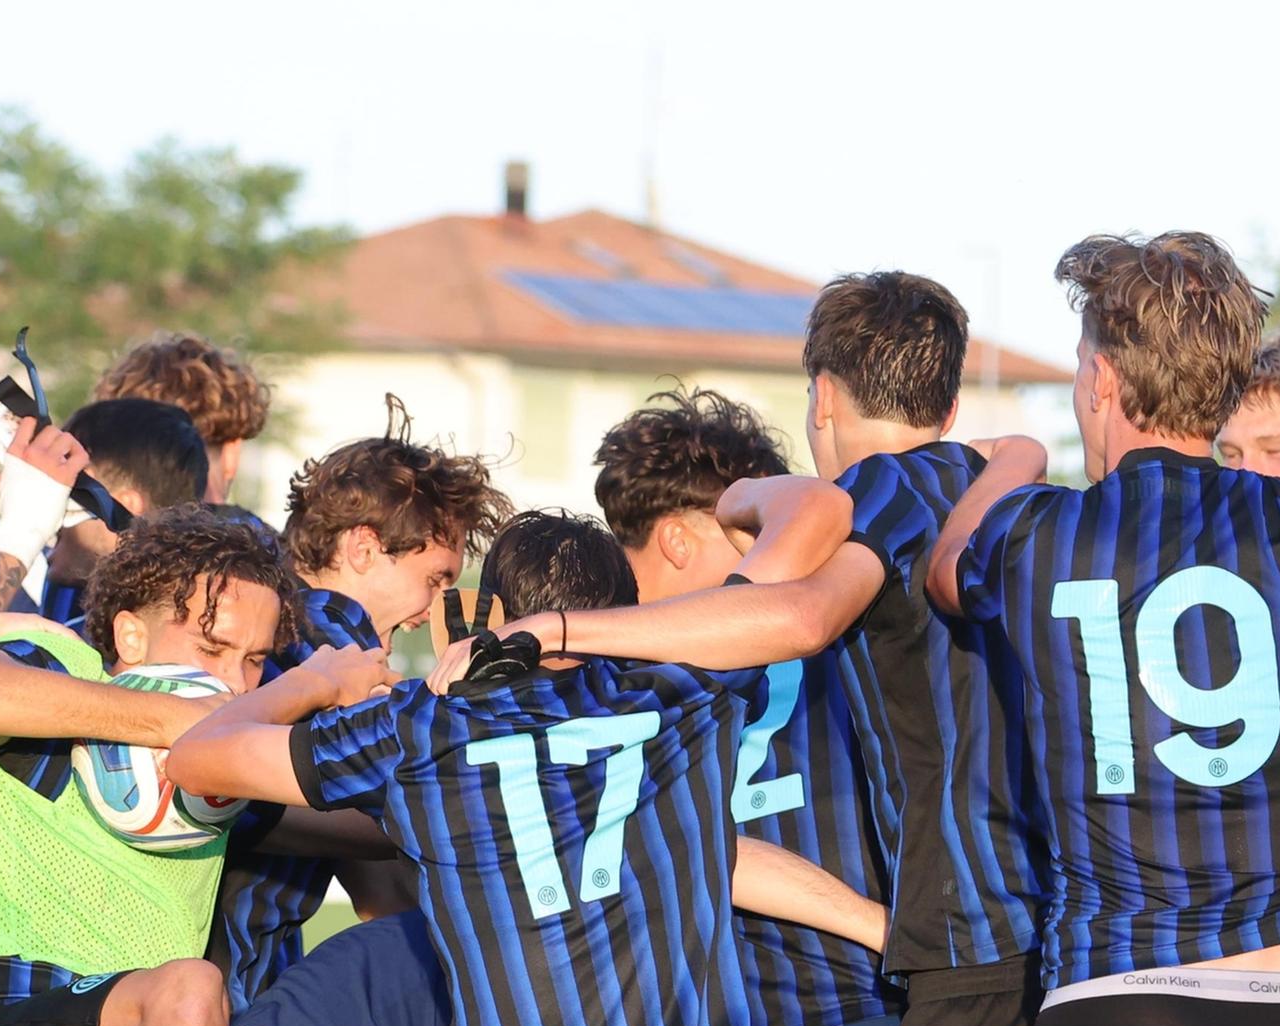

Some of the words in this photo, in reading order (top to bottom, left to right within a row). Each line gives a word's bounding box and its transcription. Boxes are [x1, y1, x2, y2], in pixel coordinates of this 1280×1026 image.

[466, 711, 661, 920] 17
[1123, 974, 1167, 986] Calvin
[1169, 976, 1201, 988] Klein
